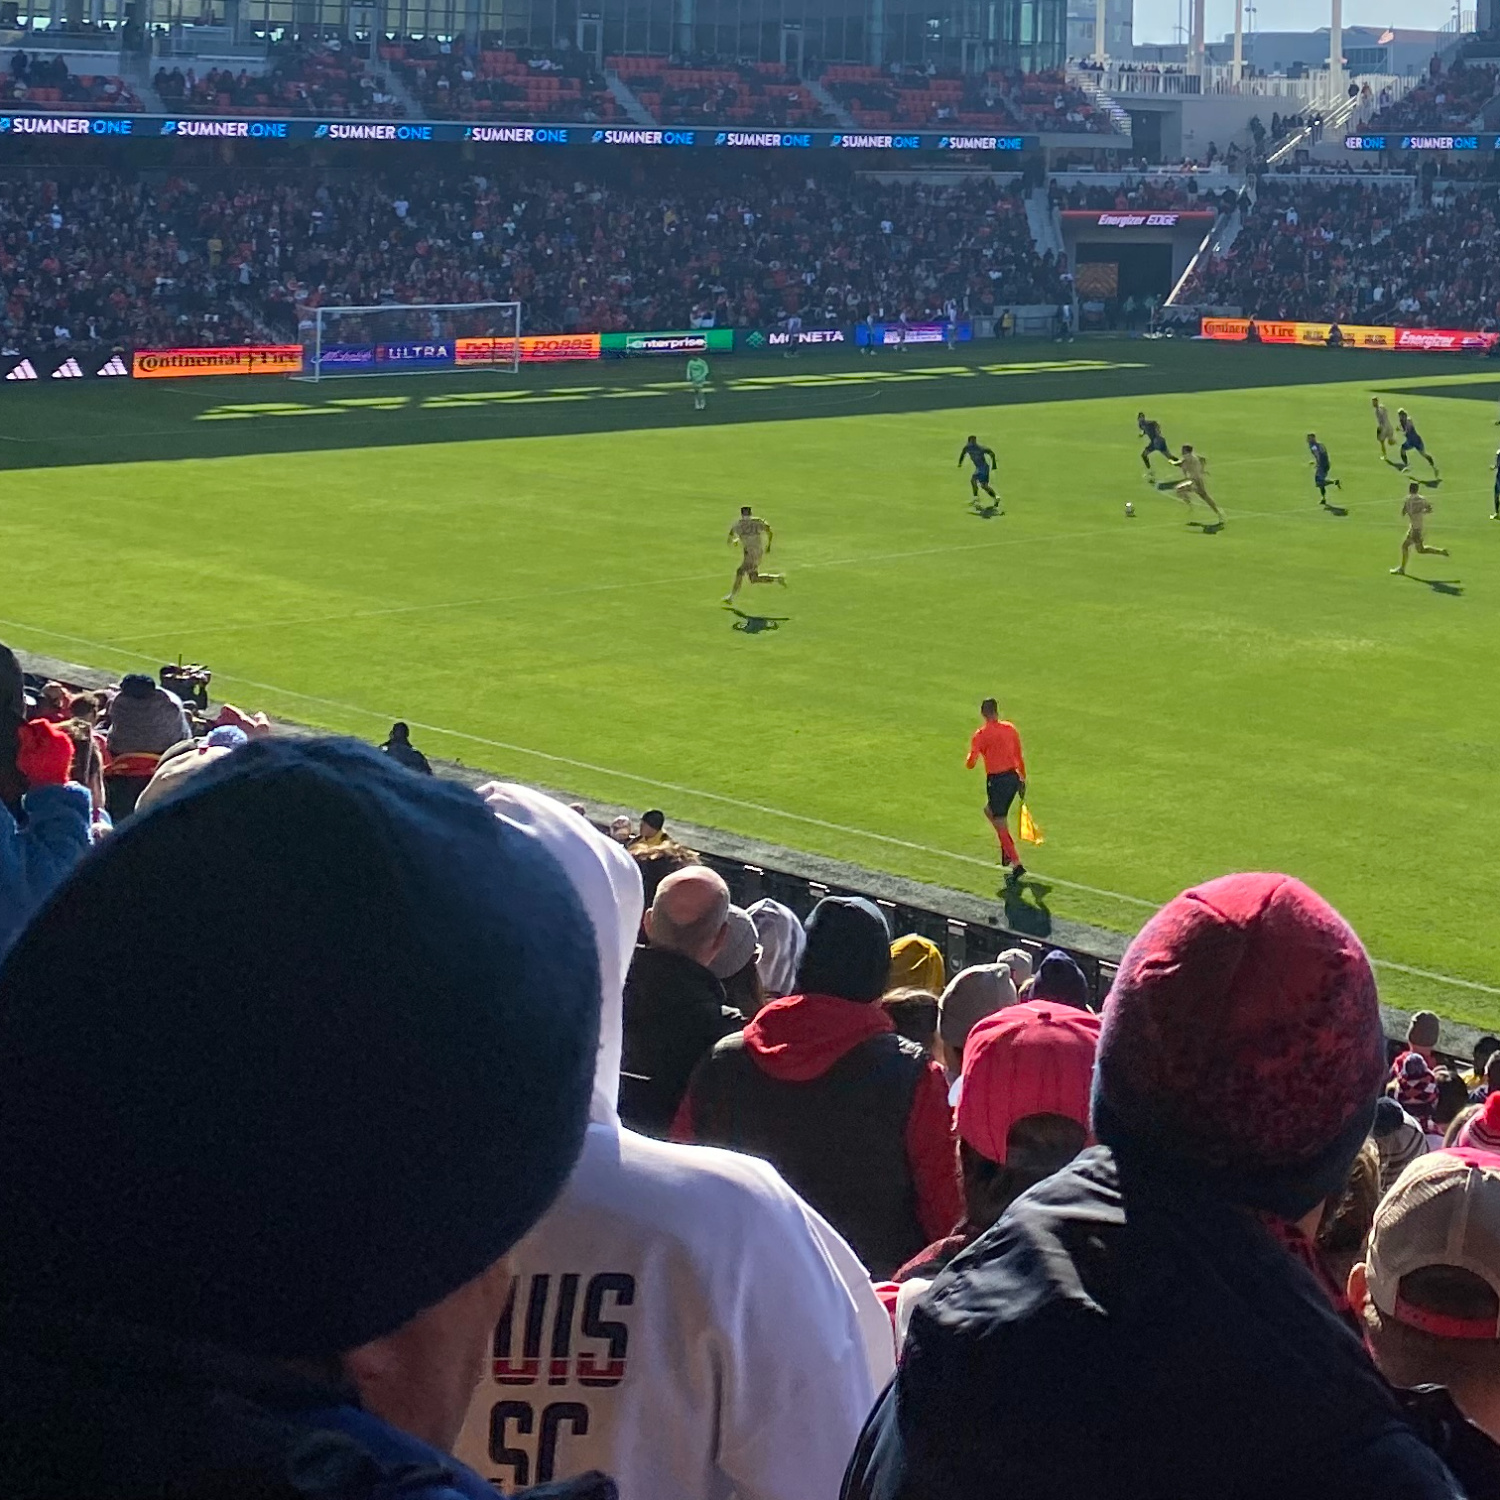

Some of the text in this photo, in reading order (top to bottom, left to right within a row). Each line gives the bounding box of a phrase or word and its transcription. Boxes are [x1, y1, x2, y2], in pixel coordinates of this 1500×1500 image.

[1098, 214, 1180, 227] Energizer EDGE
[631, 337, 706, 349] enterprise
[388, 345, 448, 360] ULTRA
